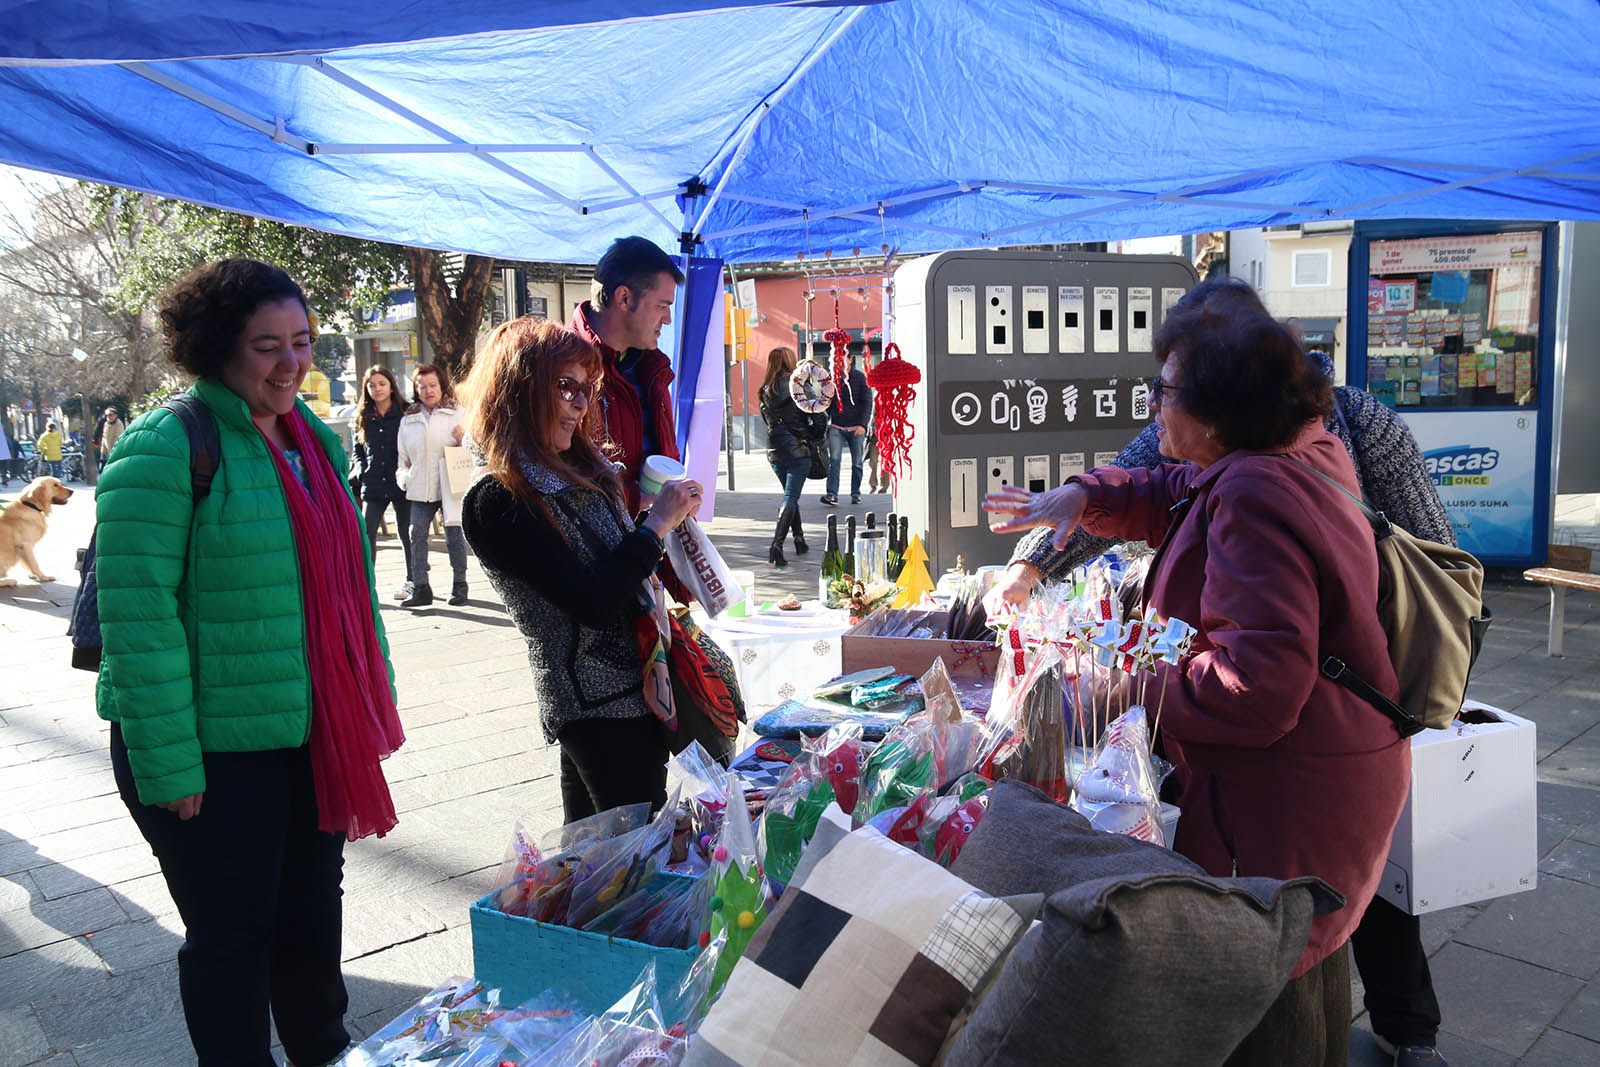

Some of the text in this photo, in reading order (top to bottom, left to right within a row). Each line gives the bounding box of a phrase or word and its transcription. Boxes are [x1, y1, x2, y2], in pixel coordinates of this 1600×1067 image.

[1438, 249, 1466, 257] premis
[1381, 257, 1403, 266] gener
[1424, 451, 1498, 474] ascas
[1455, 476, 1489, 485] ONCE
[1479, 500, 1509, 508] SUMA
